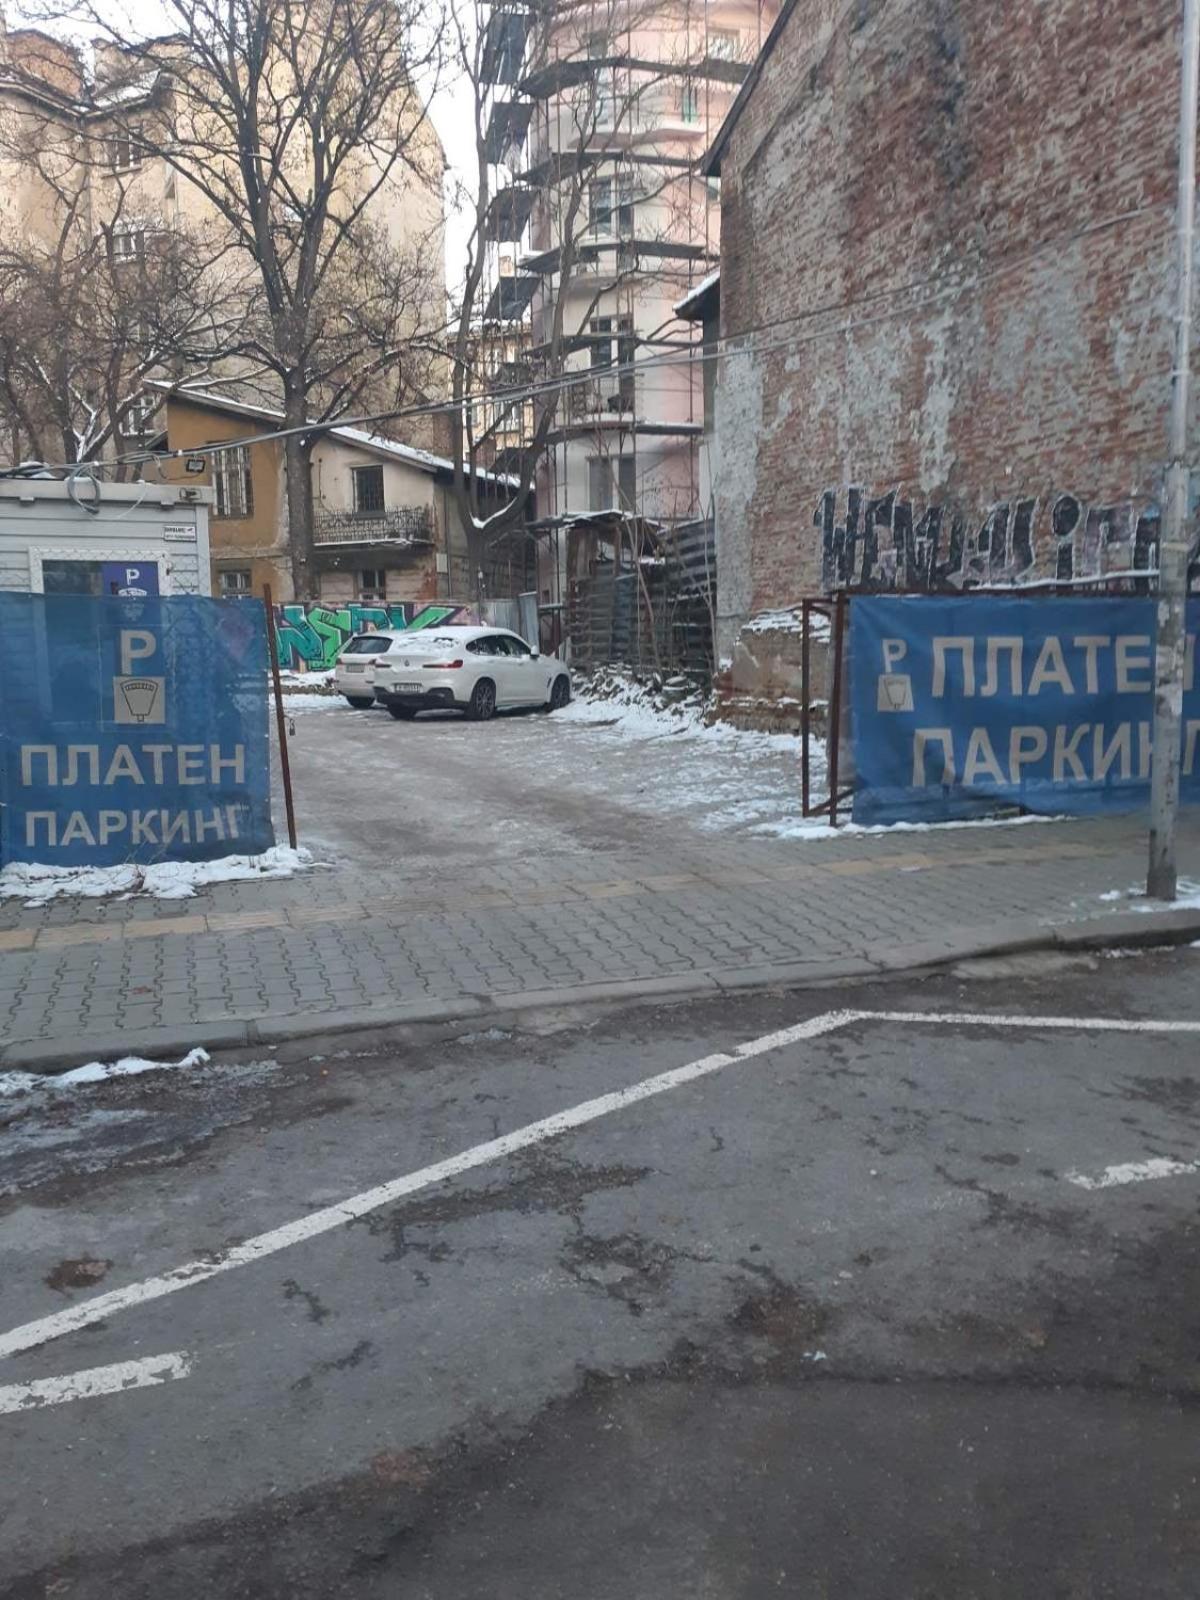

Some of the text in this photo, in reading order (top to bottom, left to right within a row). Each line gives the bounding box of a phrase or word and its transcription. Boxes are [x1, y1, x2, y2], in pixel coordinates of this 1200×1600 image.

[126, 568, 140, 585] P
[120, 629, 157, 675] P
[882, 638, 907, 673] P
[21, 744, 245, 786] ПЛАТЕН
[25, 804, 249, 847] ПАРКИНГ
